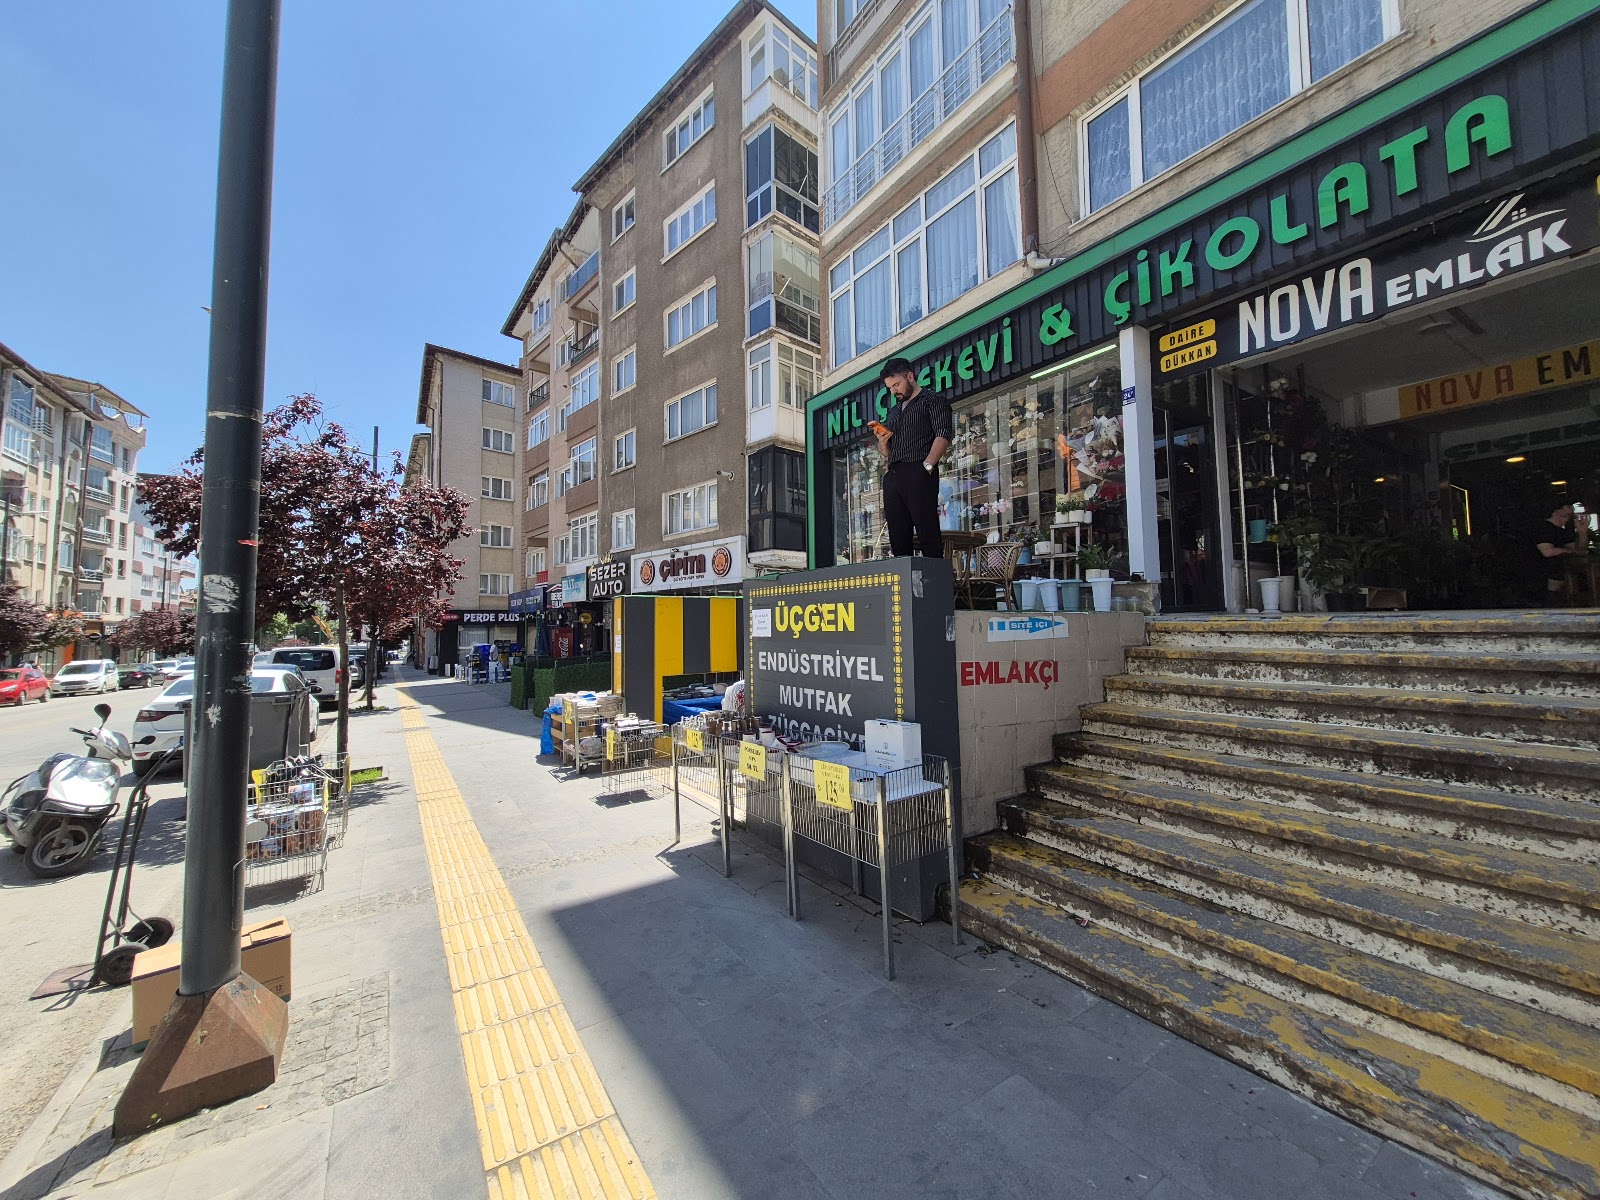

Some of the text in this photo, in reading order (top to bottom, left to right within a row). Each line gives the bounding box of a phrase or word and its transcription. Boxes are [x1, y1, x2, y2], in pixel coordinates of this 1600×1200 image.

[828, 94, 1511, 439] NİL ÇEKEVİ & ÇİKOLATA
[1238, 218, 1572, 355] NOVA EMLAK
[1169, 325, 1204, 347] DAİRE
[1165, 345, 1212, 369] DÜKKAN
[1415, 365, 1514, 411] NOVA
[590, 562, 626, 582] SEZER
[659, 552, 706, 582] ÇİPİTA
[592, 579, 623, 597] AUTO
[463, 613, 495, 622] PERDE
[498, 613, 520, 622] PLUS
[775, 601, 855, 638] ÜÇGEN
[758, 649, 884, 682] ENDÜSTRİYEL
[961, 660, 1059, 690] EMLAKÇI
[779, 685, 853, 717] MUTFAK
